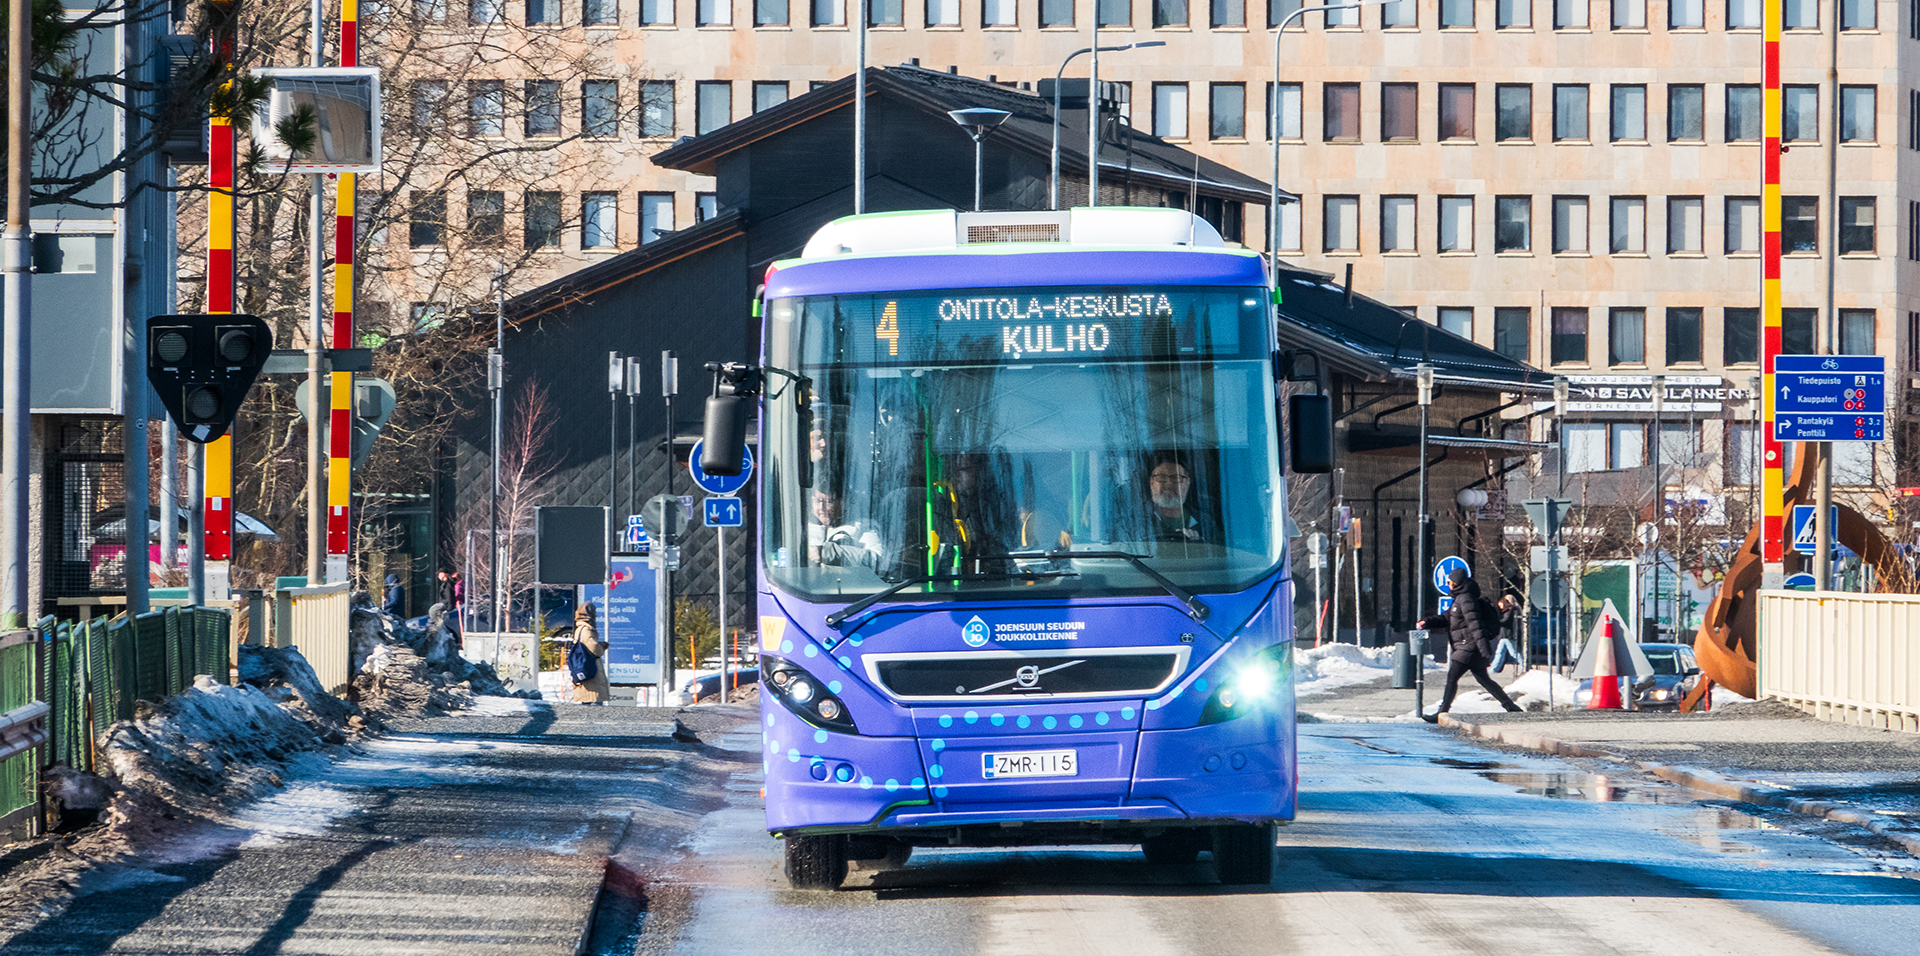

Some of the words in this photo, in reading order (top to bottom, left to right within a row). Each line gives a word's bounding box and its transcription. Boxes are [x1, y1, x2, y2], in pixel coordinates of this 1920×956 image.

[939, 294, 1173, 320] ONTTOLA-KESKUSTA
[876, 301, 899, 356] 4
[1002, 324, 1110, 353] KULHO
[1798, 376, 1841, 386] Tiedepuisto
[1797, 395, 1837, 404] Kauppatori
[1797, 416, 1834, 426] Rantakylä
[1797, 429, 1826, 437] Penttilä
[765, 621, 776, 636] W
[970, 624, 983, 632] JO
[995, 623, 1045, 632] JOENSUUN
[1047, 621, 1085, 631] SEUDUN
[970, 633, 983, 642] JO
[995, 631, 1078, 642] JOUKKOLIIKENNE
[998, 755, 1072, 773] ZMR-115
